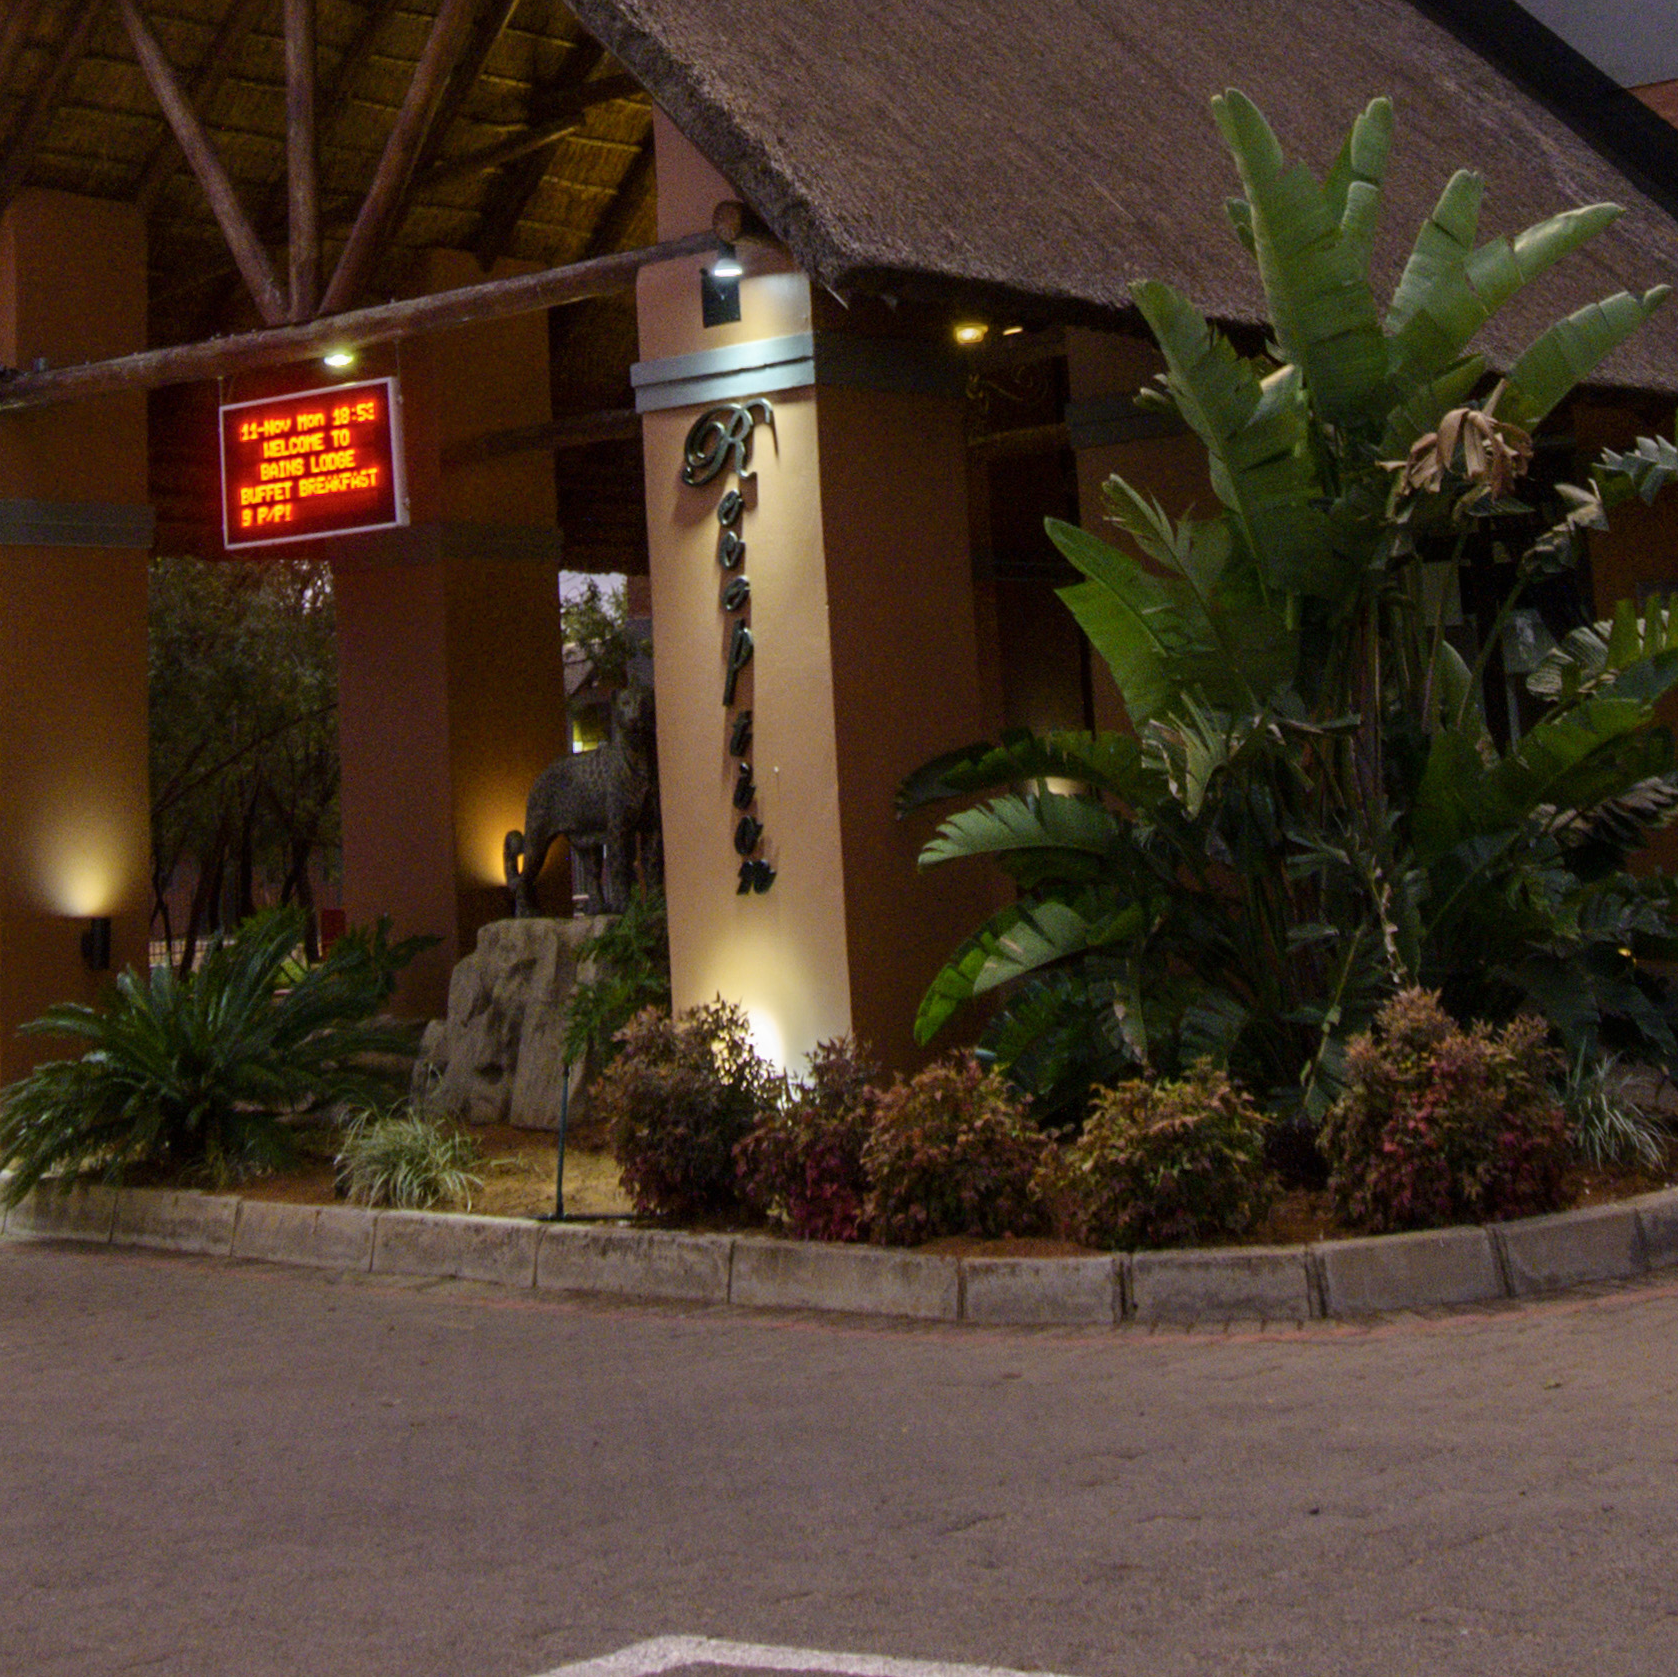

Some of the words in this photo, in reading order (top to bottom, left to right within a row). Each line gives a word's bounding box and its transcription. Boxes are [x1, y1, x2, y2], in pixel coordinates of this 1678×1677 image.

[262, 432, 326, 459] WELCOME
[331, 428, 351, 447] TO
[260, 456, 305, 482] BAINS
[310, 449, 356, 474] LODGE
[240, 481, 293, 506] BUFFET
[298, 467, 378, 497] BREAKFAST
[682, 397, 777, 895] Reception
